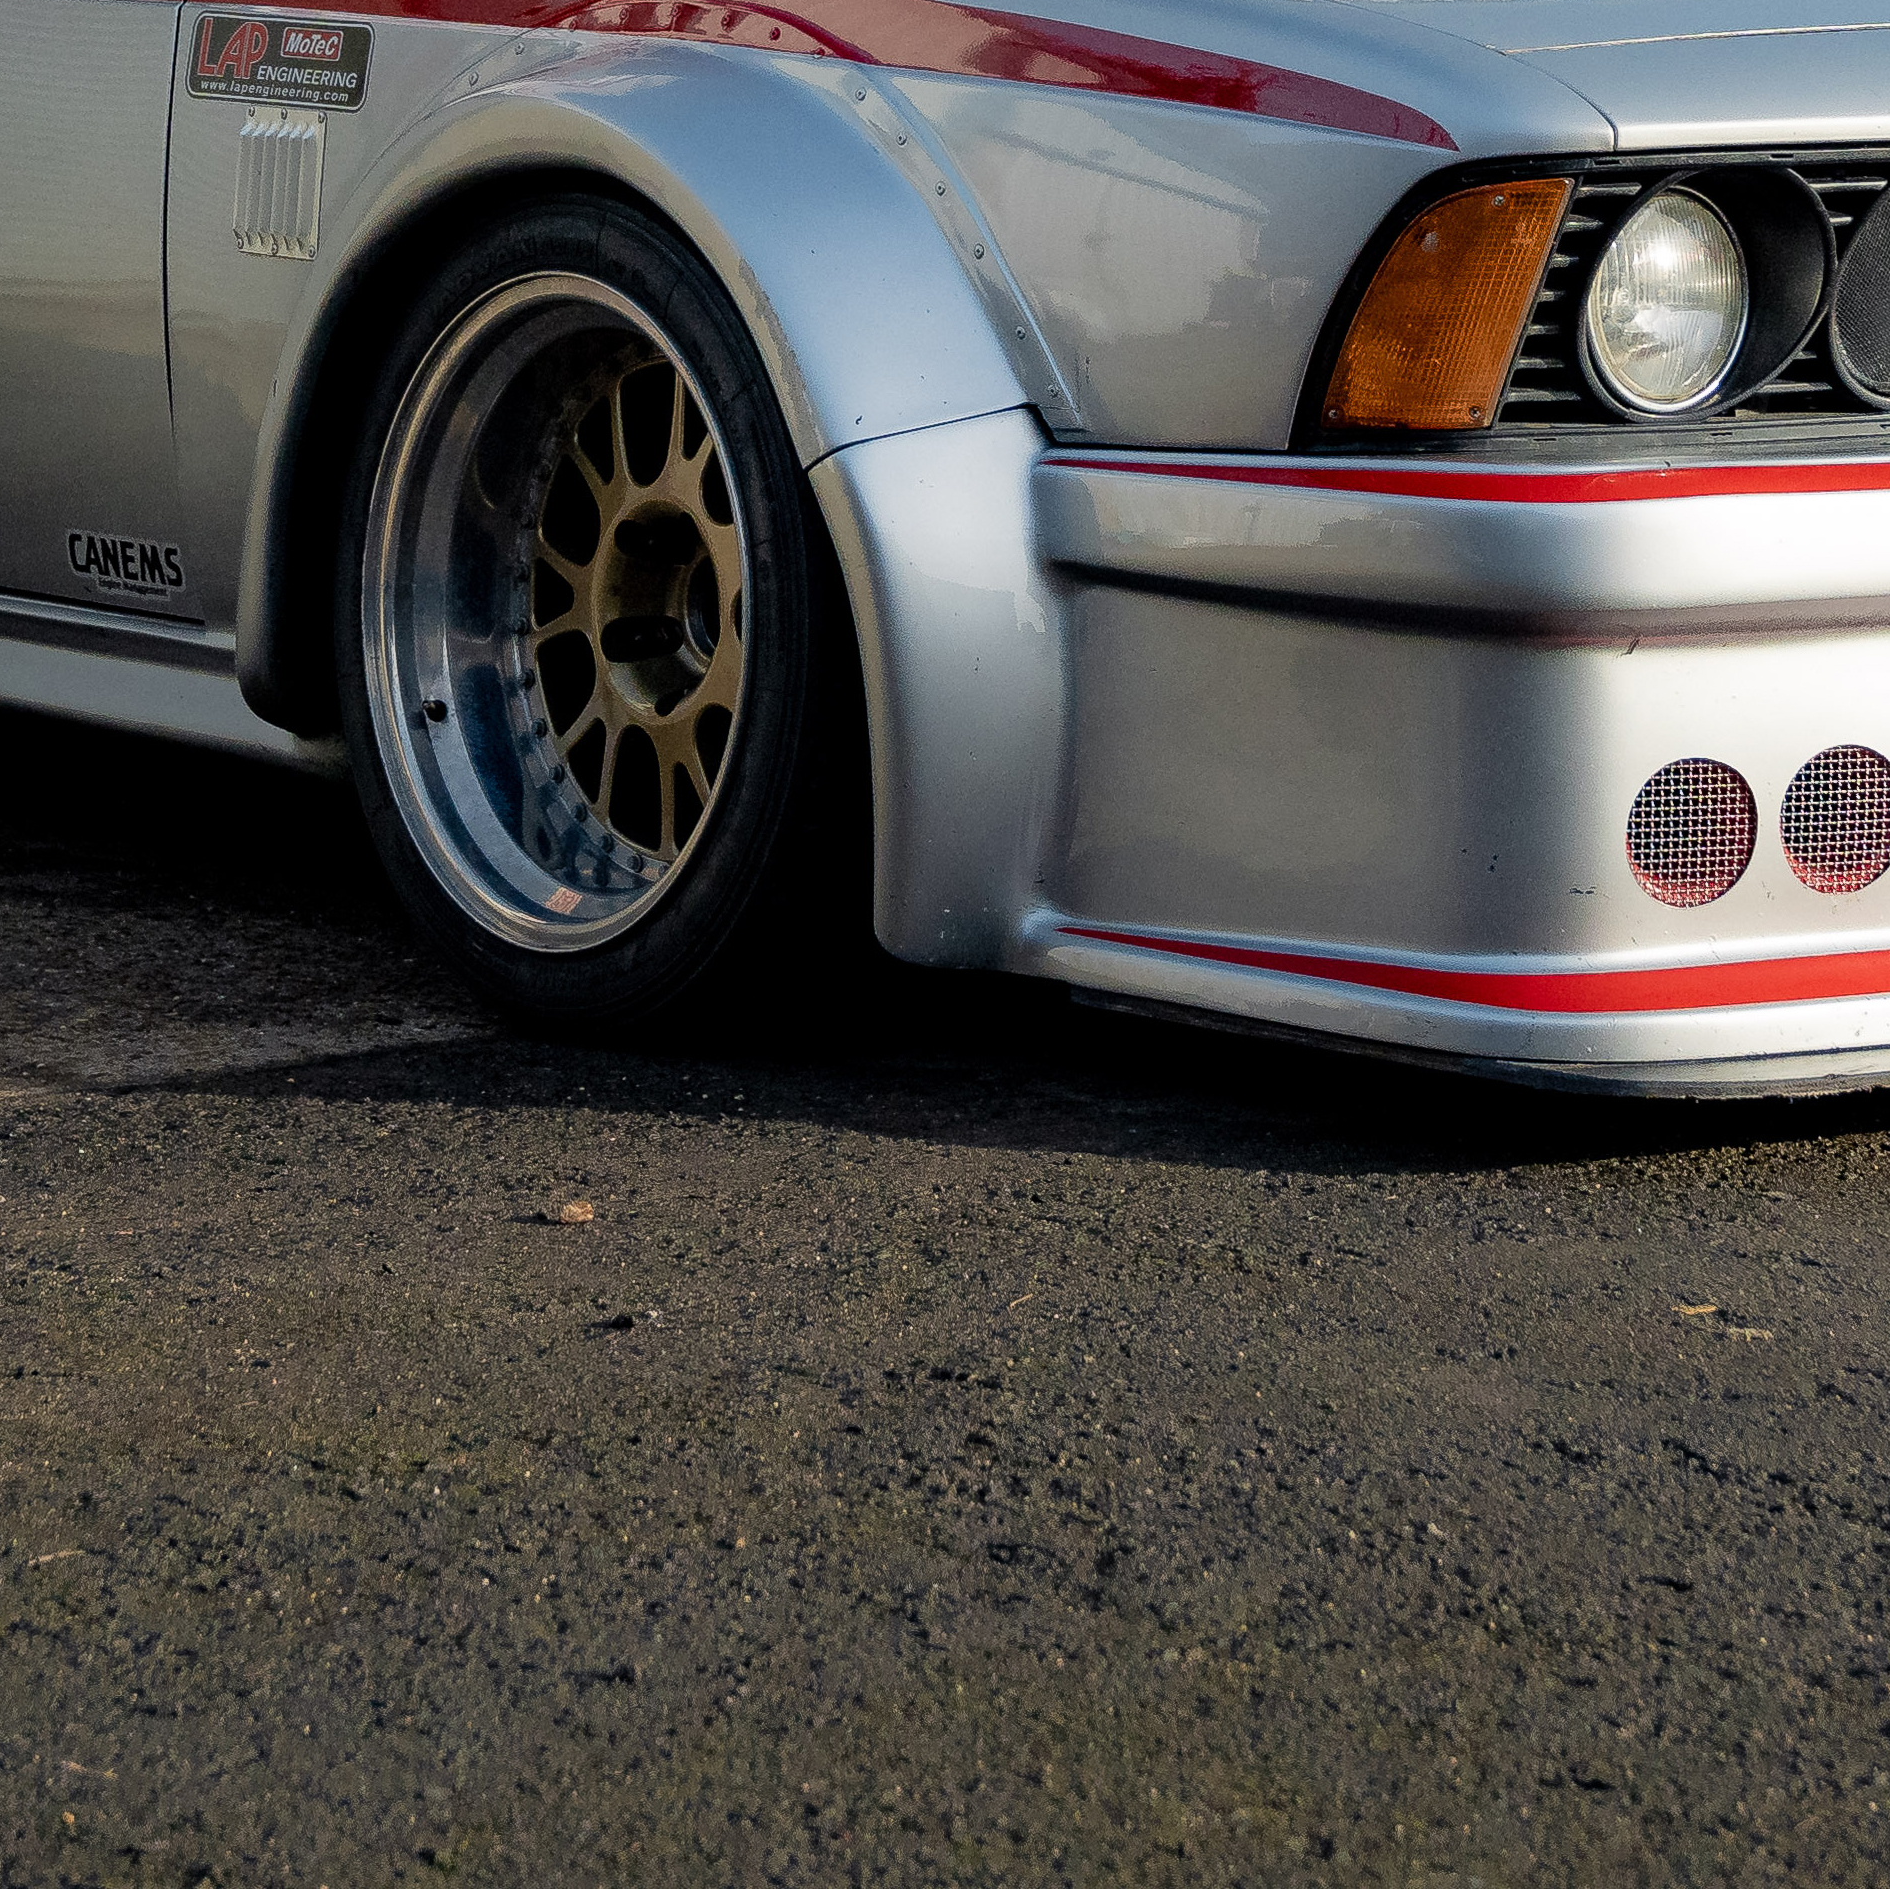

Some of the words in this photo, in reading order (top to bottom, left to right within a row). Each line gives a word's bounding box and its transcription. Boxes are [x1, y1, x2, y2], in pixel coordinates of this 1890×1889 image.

[196, 16, 269, 81] LAP
[284, 31, 339, 57] MoTeC
[199, 79, 350, 103] www.lapengineering.com
[256, 65, 358, 89] ENGINEERING
[68, 533, 184, 587] CANEMS
